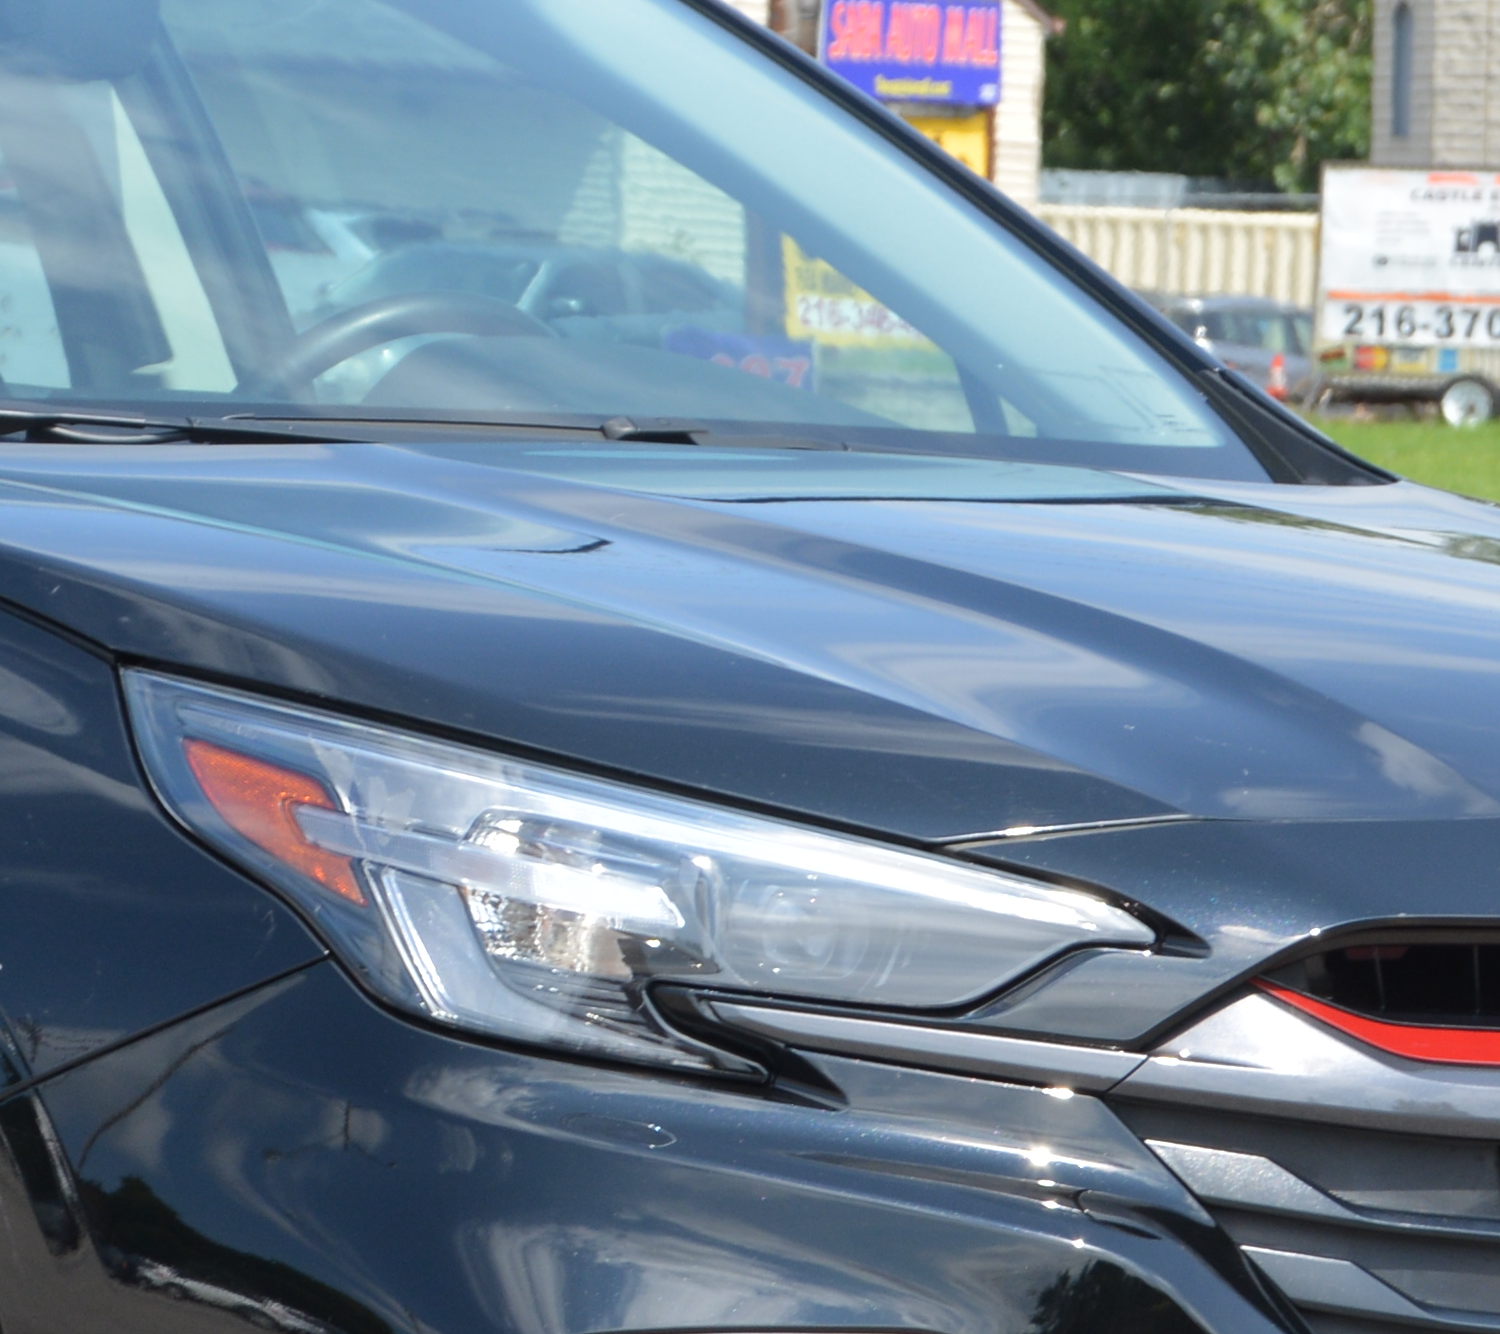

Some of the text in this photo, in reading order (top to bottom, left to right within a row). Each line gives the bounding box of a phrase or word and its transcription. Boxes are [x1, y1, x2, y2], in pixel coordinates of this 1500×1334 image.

[828, 0, 998, 66] SARA AUTO MALL
